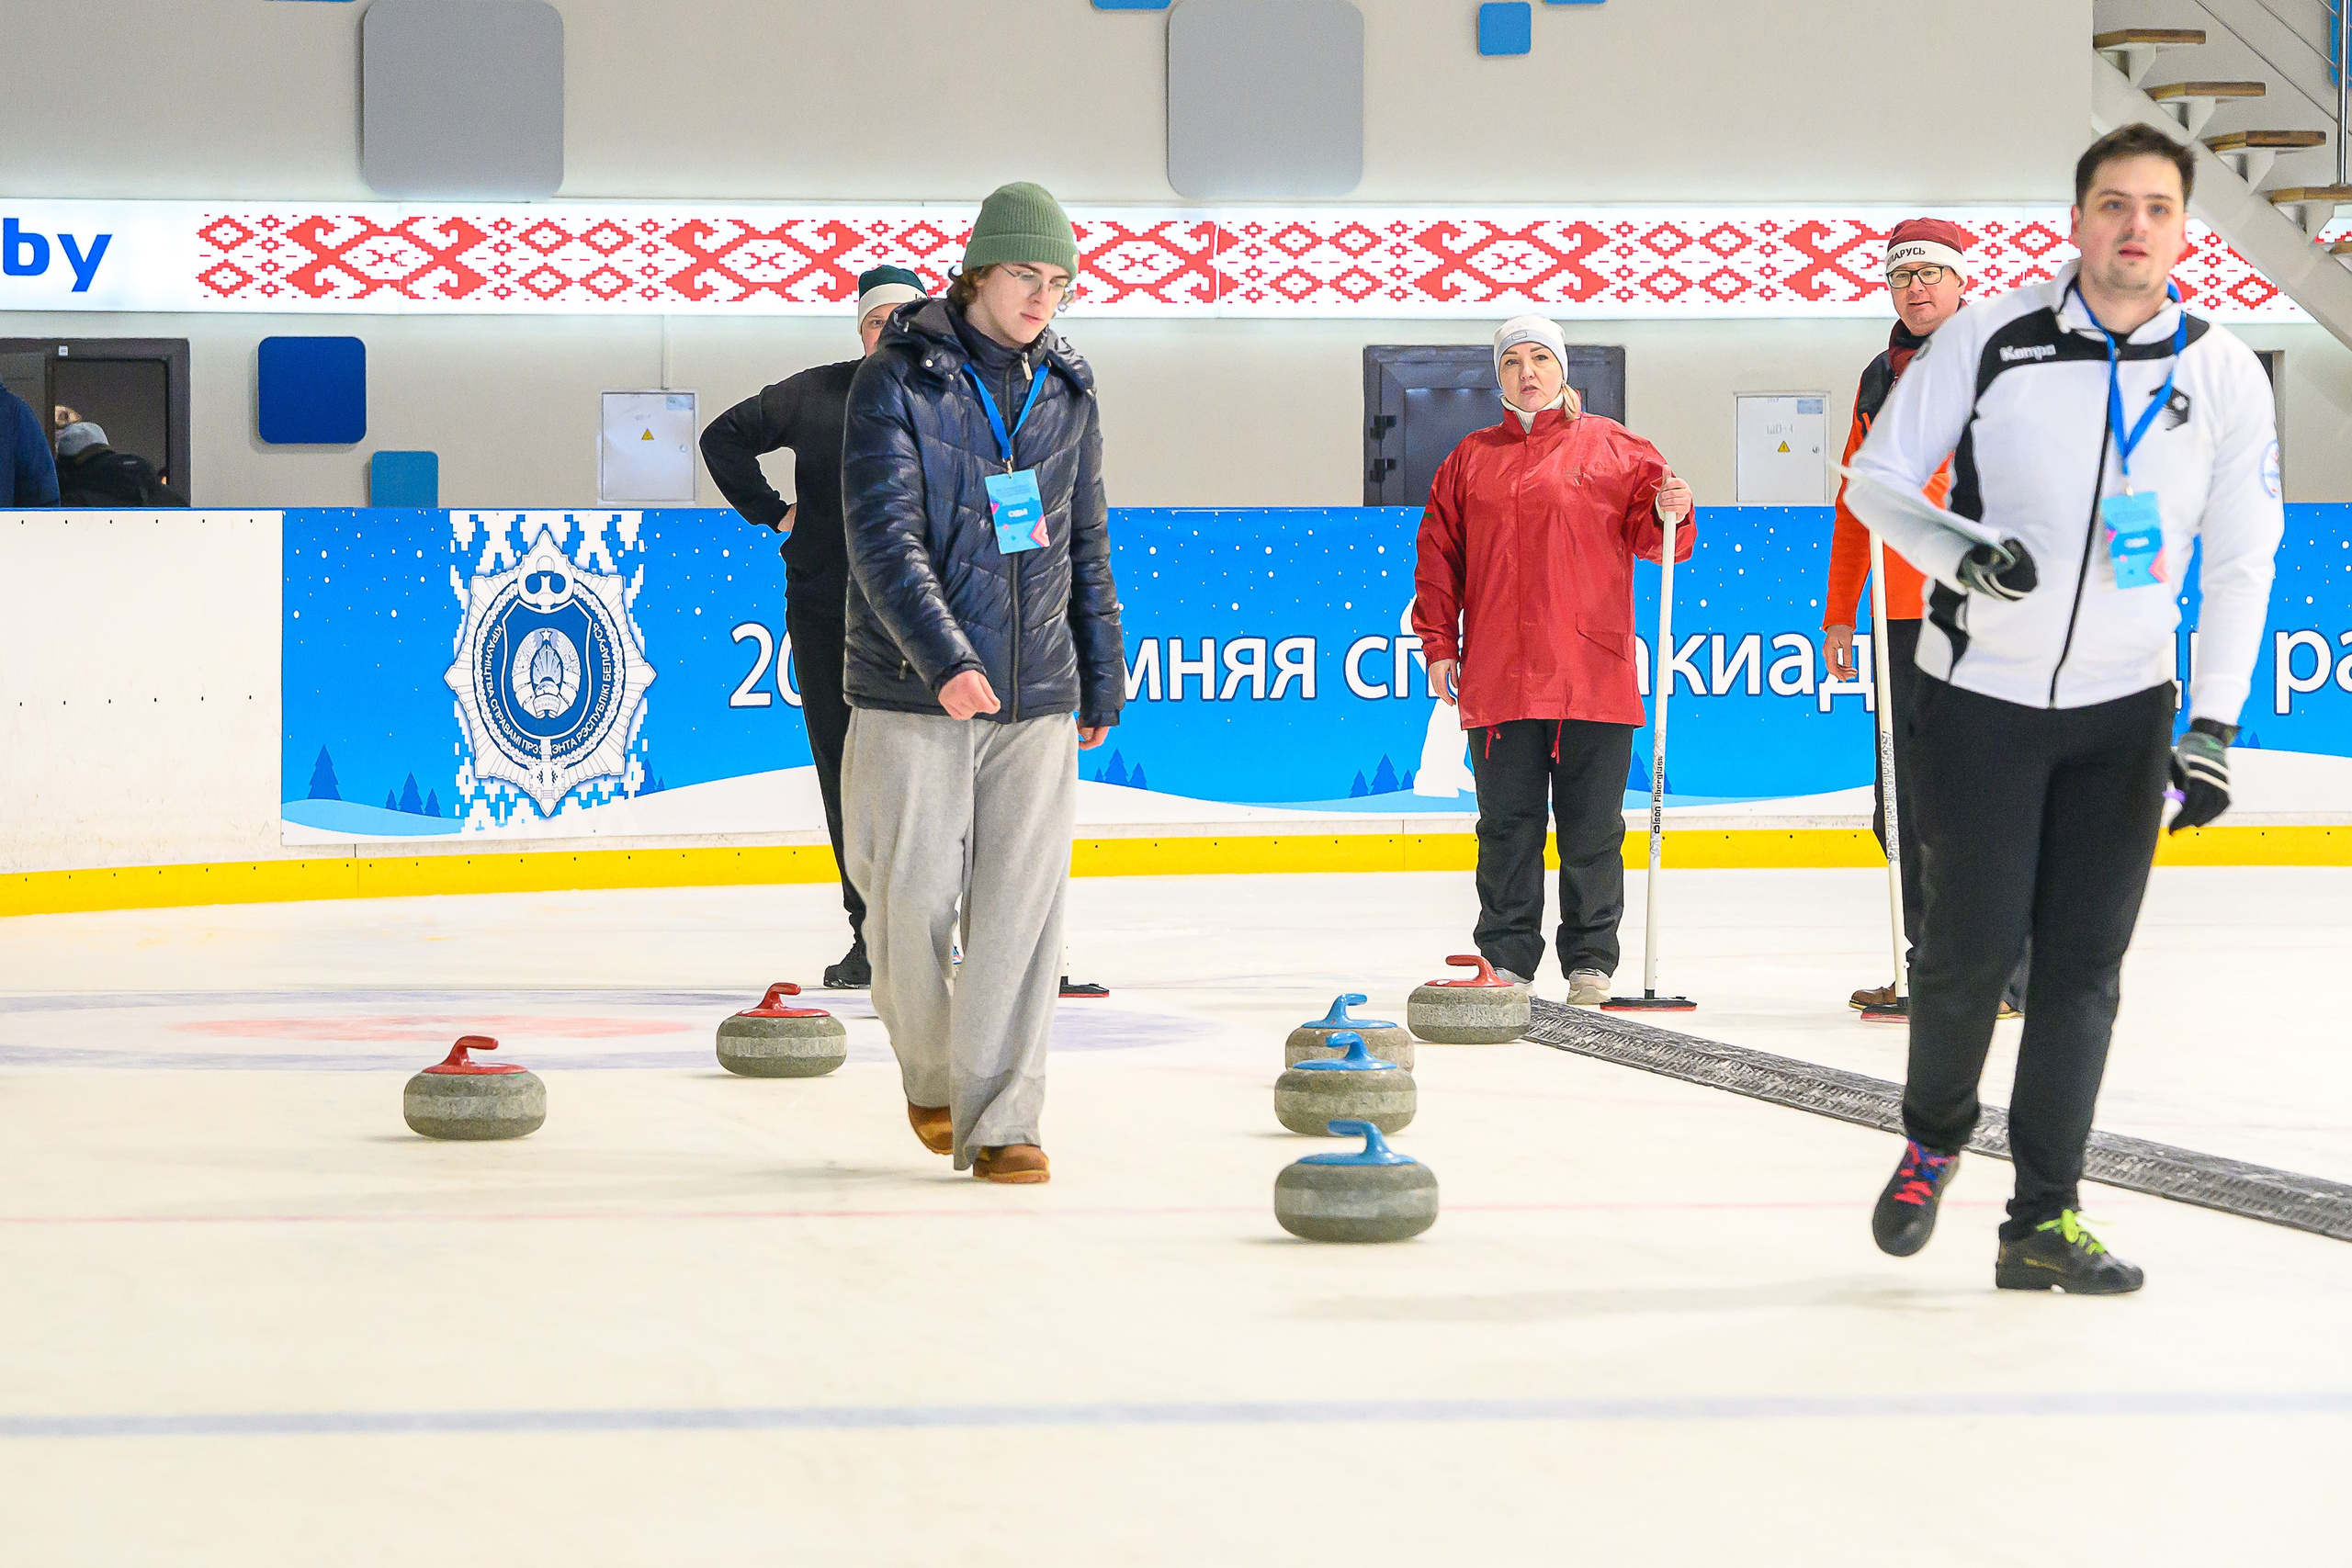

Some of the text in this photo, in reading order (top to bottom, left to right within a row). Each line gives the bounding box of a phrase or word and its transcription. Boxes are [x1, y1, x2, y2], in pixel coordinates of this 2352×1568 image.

[3, 217, 113, 293] by
[1999, 344, 2057, 362] Kempa
[490, 698, 523, 746] СПРАВАМІ
[521, 738, 578, 755] ПРЭЭНТА
[593, 622, 612, 682] БЕЛАРУСЬ
[1122, 637, 1317, 701] мняя
